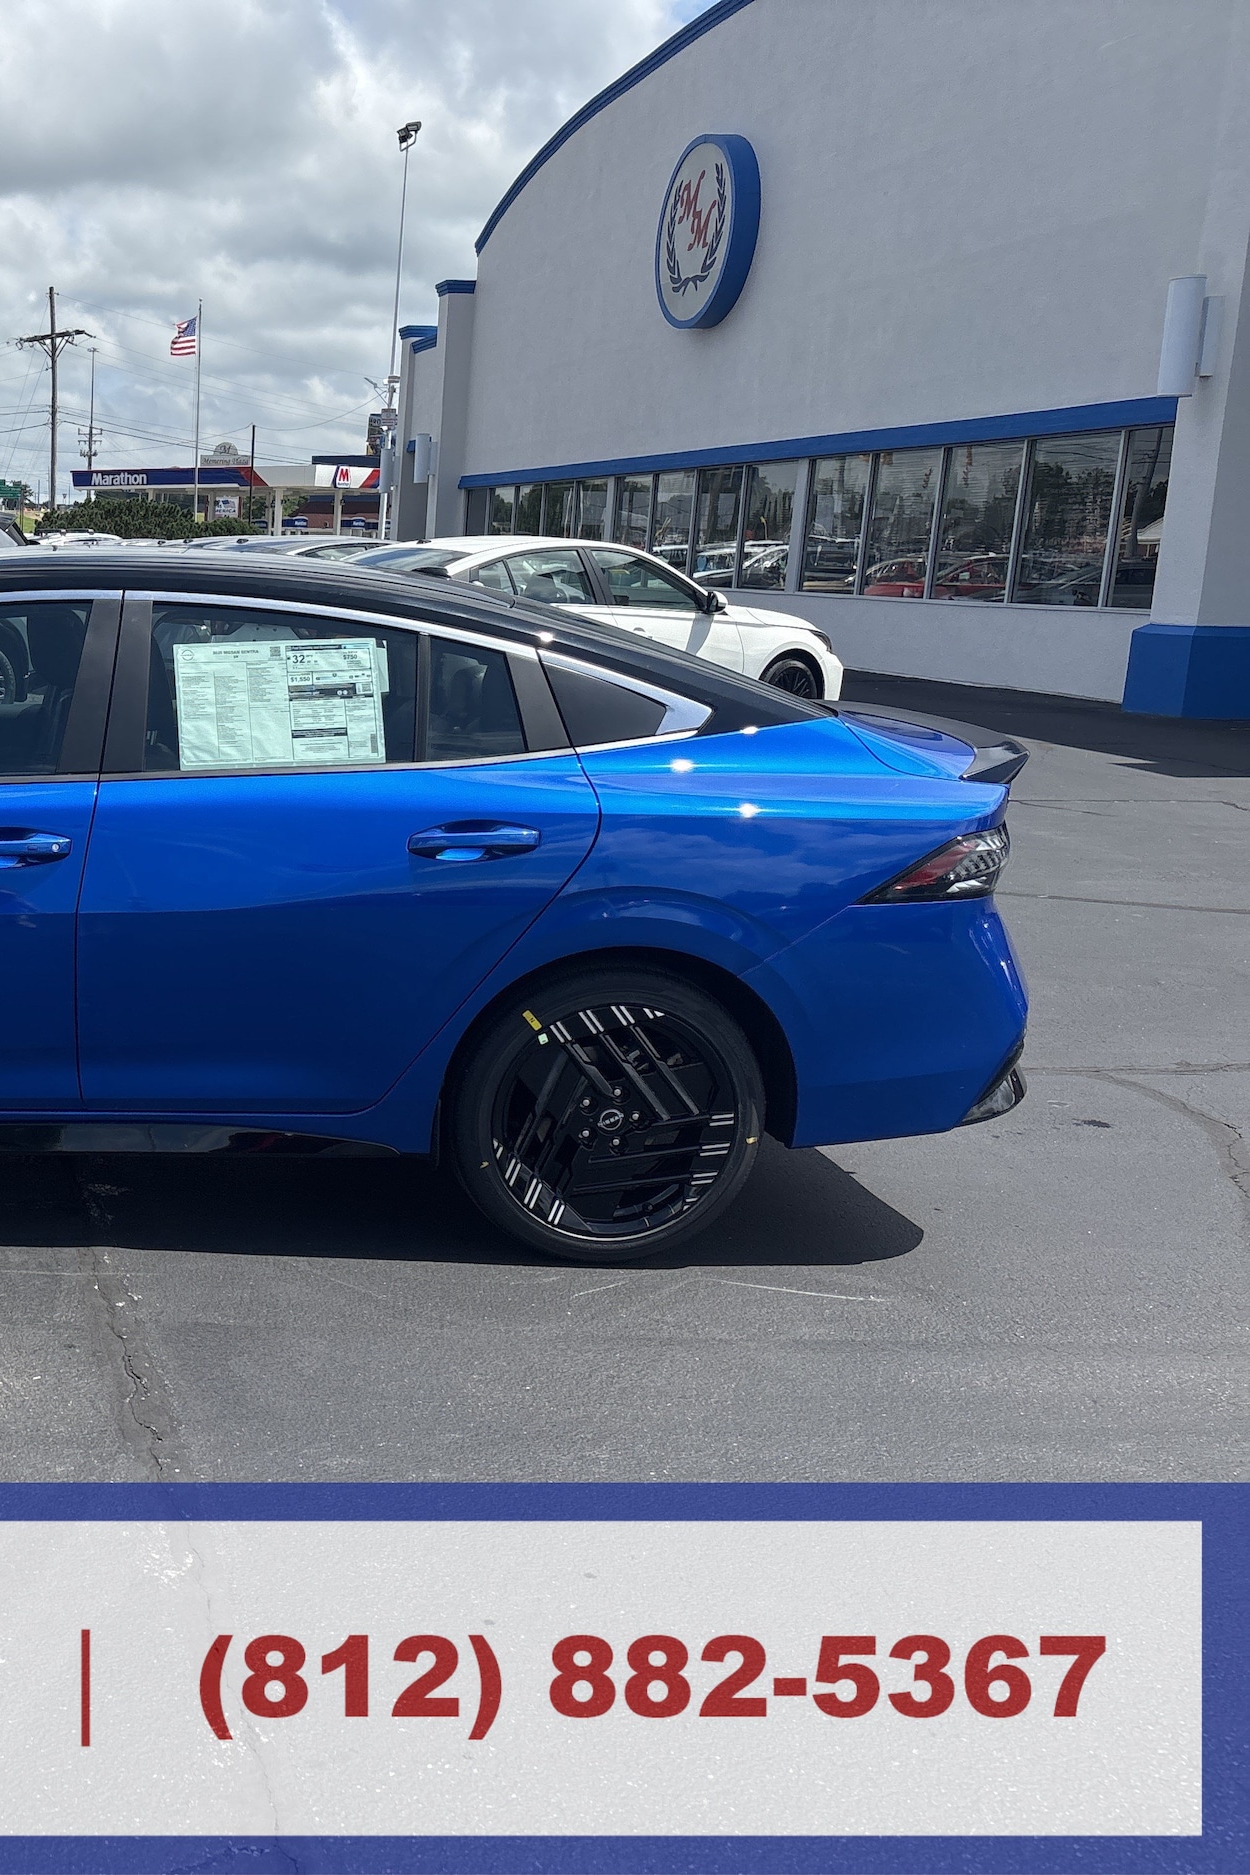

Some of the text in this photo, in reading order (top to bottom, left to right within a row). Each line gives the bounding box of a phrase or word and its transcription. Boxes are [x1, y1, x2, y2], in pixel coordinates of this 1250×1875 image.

[91, 473, 147, 486] Marathon
[338, 468, 349, 482] M
[292, 654, 306, 664] 32
